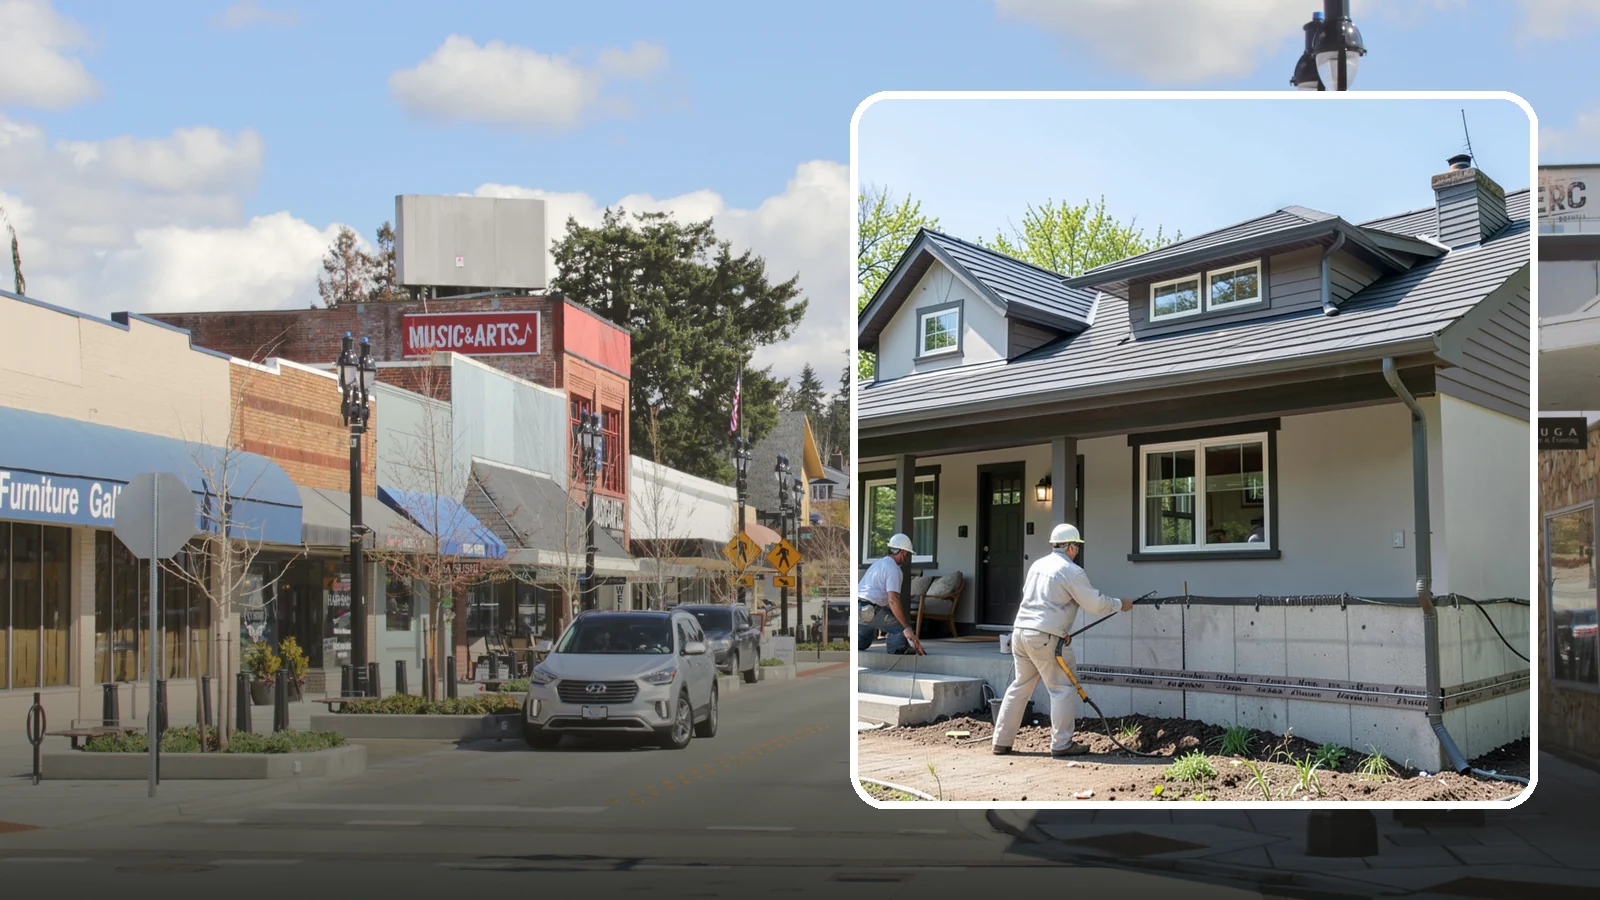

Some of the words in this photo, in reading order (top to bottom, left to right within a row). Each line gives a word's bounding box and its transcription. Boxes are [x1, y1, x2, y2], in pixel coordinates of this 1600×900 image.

[408, 323, 520, 349] MUSIC&ARTS
[1540, 427, 1578, 437] UGA
[0, 471, 80, 515] Furniture
[89, 482, 122, 519] Gal
